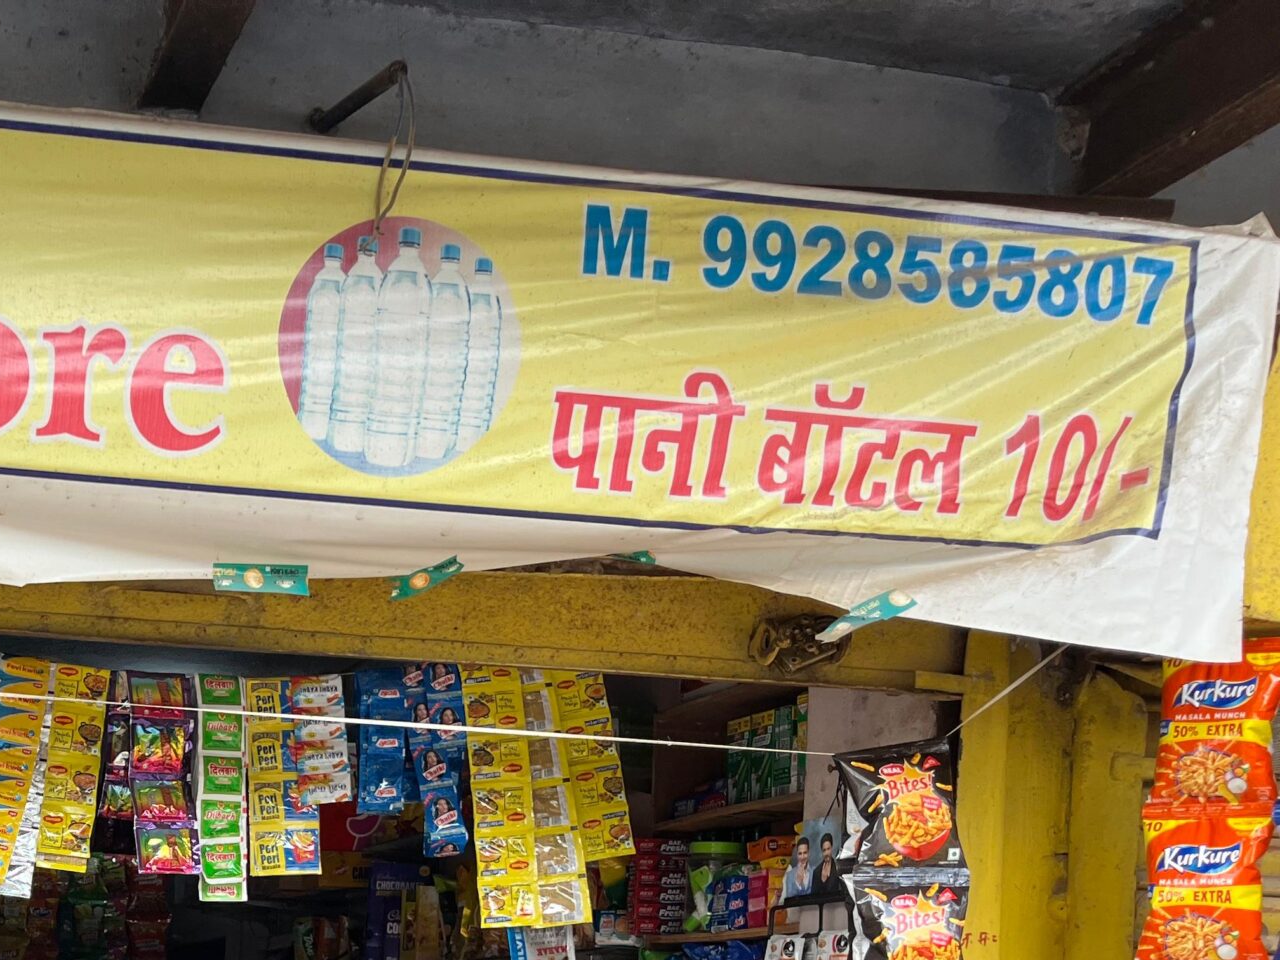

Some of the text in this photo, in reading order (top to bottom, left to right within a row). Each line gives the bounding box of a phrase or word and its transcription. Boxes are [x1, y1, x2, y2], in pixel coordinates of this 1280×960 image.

[582, 204, 1174, 326] M. 9928585807
[553, 372, 1149, 525] पानी बॉटल 10/-
[1180, 679, 1255, 707] Kurkure
[1173, 722, 1243, 738] 50% EXTRA
[888, 774, 932, 797] Bites!
[1164, 845, 1239, 872] Kurkure
[895, 898, 915, 906] REAL
[1157, 889, 1232, 904] 50% EXTRA
[896, 909, 946, 933] Bites!
